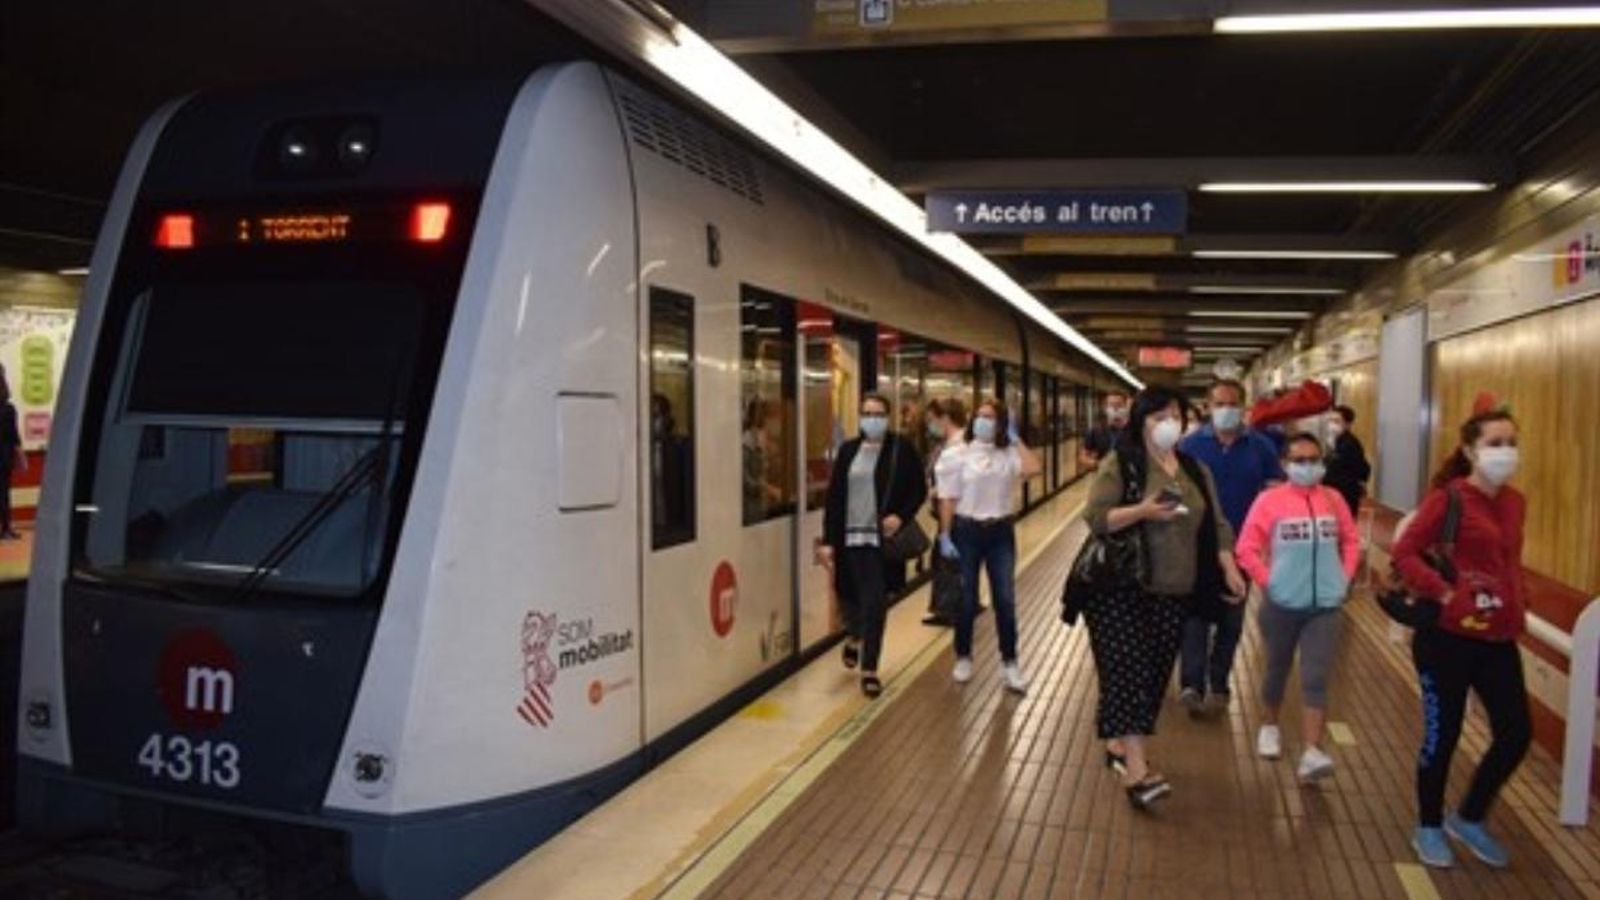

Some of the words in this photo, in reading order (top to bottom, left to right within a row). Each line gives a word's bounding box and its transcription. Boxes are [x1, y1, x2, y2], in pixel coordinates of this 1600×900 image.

[261, 215, 350, 240] TORRENT
[1058, 201, 1080, 223] al
[1089, 201, 1138, 223] tren
[559, 629, 633, 668] mobilitat
[187, 666, 235, 714] m
[138, 733, 241, 787] 4313
